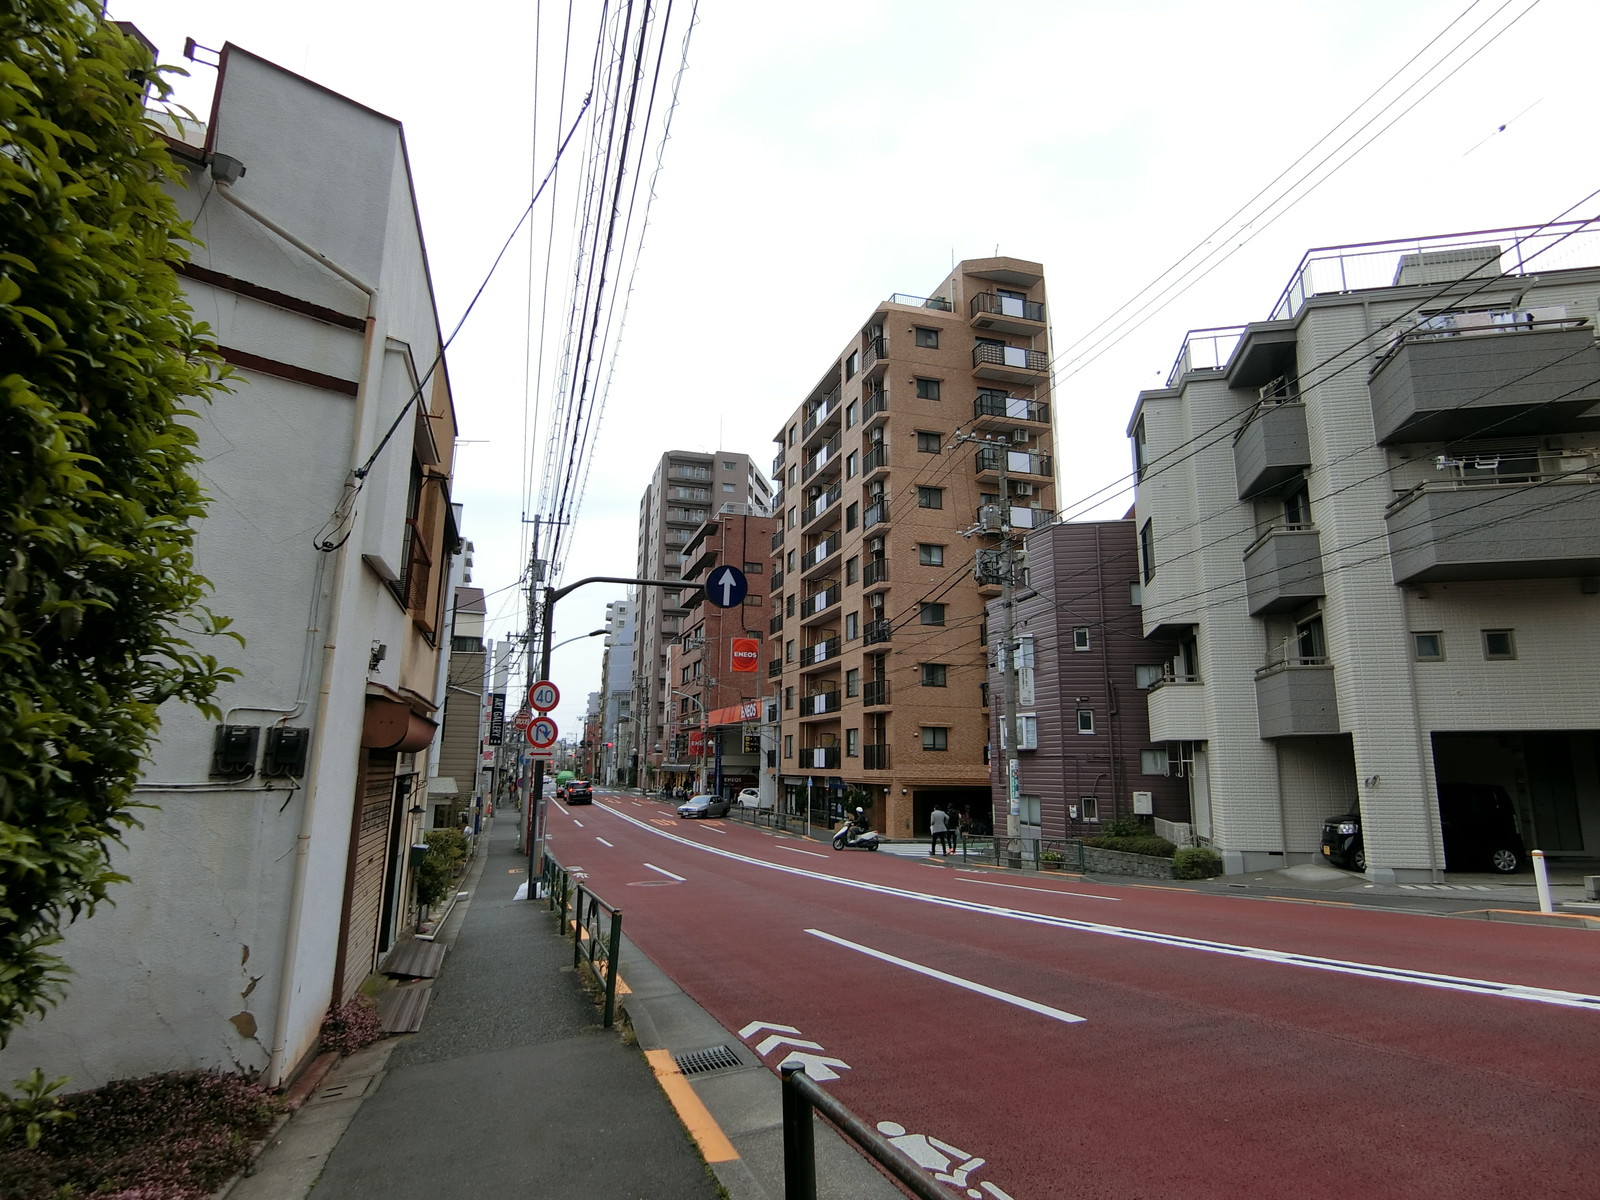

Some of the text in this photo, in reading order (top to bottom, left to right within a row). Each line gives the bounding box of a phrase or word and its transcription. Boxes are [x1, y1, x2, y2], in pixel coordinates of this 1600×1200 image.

[494, 697, 504, 709] ART
[536, 689, 553, 704] 40
[741, 703, 757, 718] ENEOS
[491, 711, 503, 737] GALLERY
